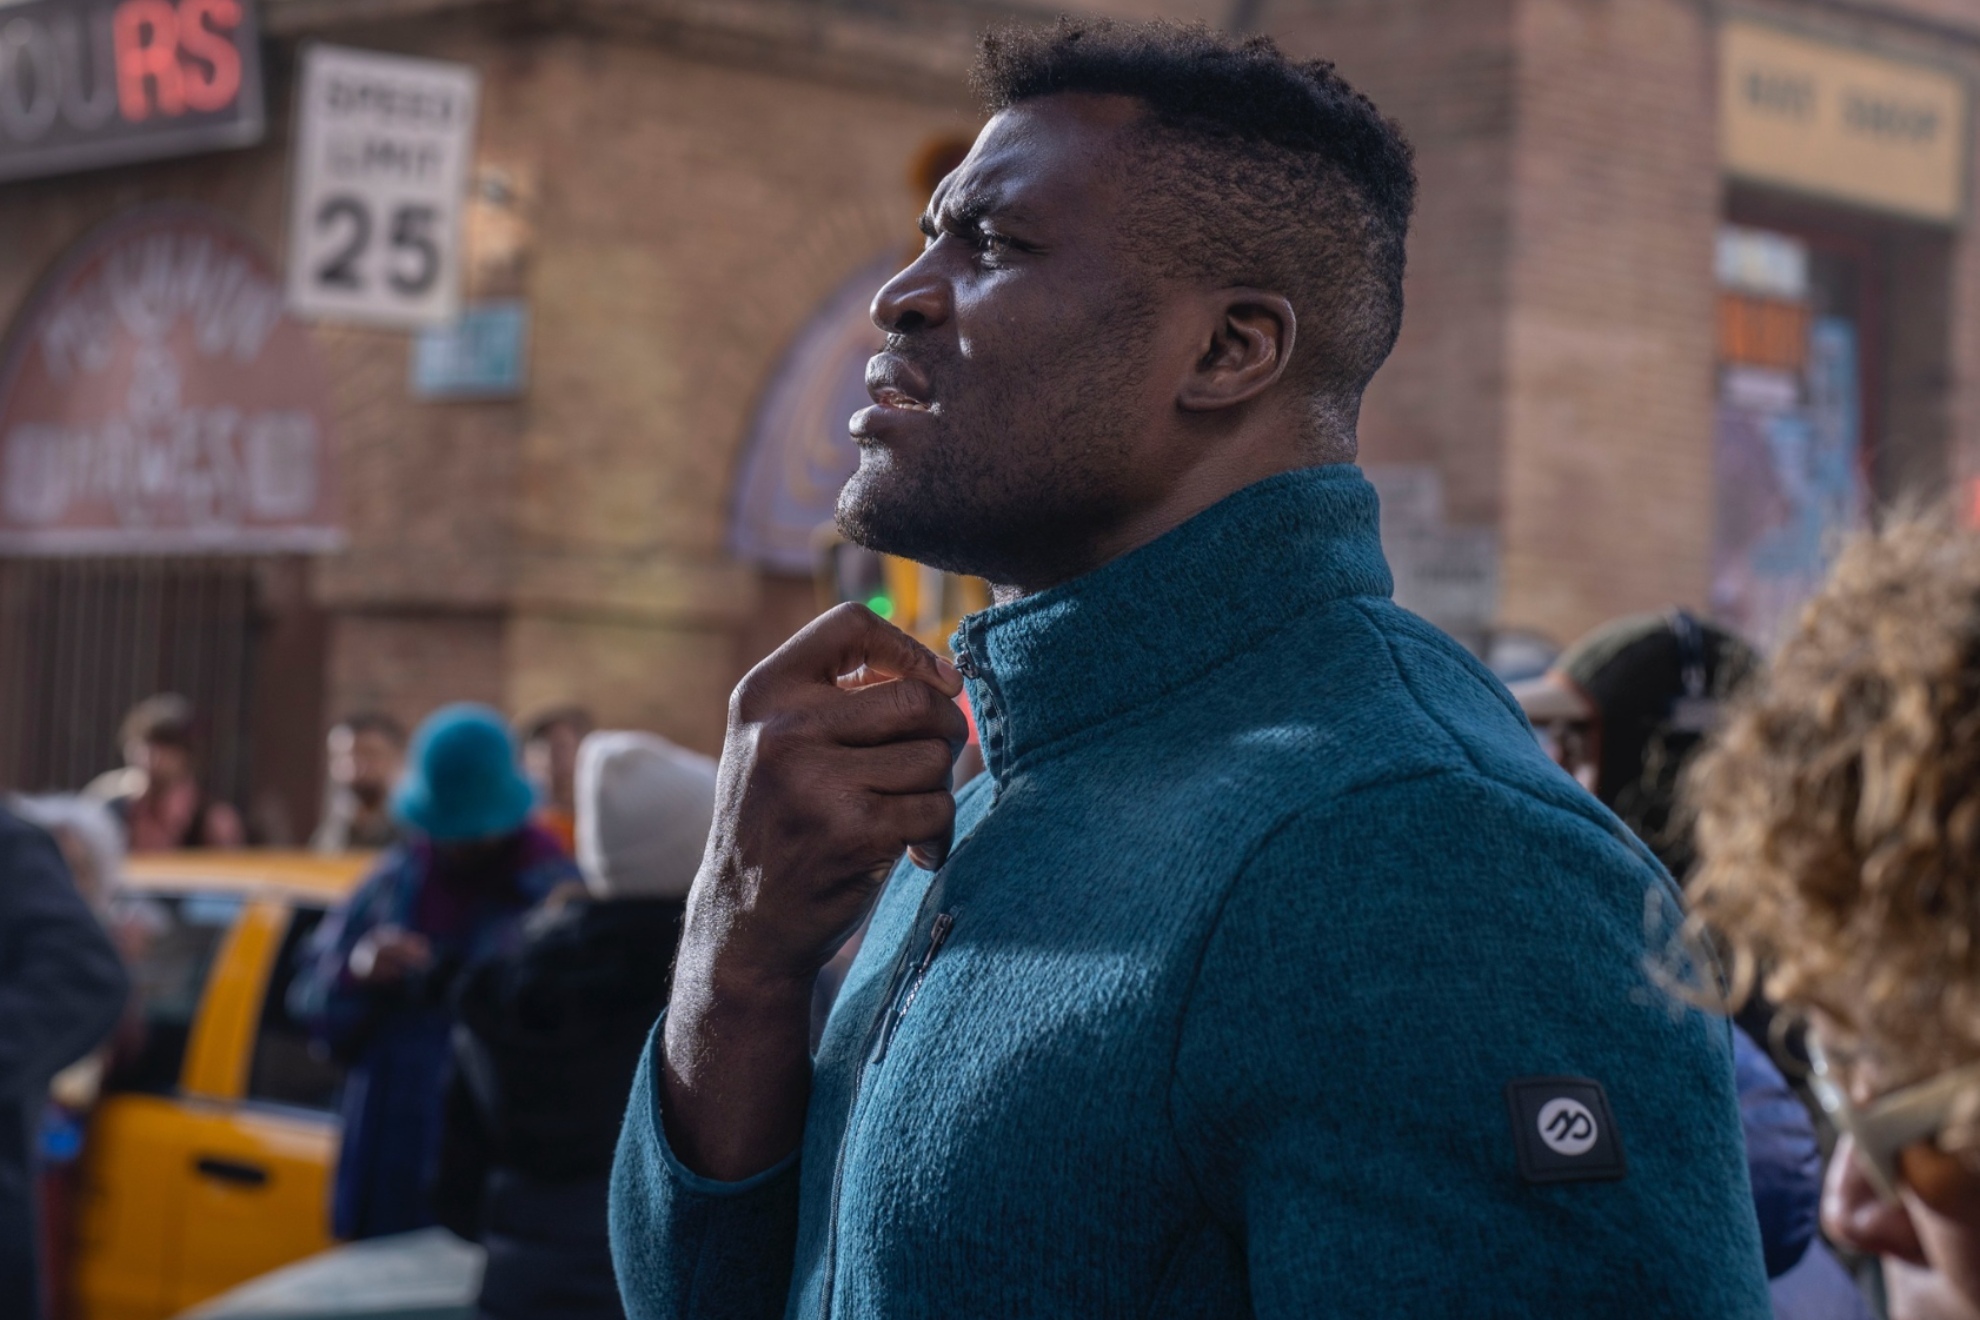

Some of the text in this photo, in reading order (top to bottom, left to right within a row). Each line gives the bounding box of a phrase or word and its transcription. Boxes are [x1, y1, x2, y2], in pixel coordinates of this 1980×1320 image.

[320, 74, 459, 126] SPEED
[327, 136, 442, 181] LIMIT
[315, 193, 440, 297] 25
